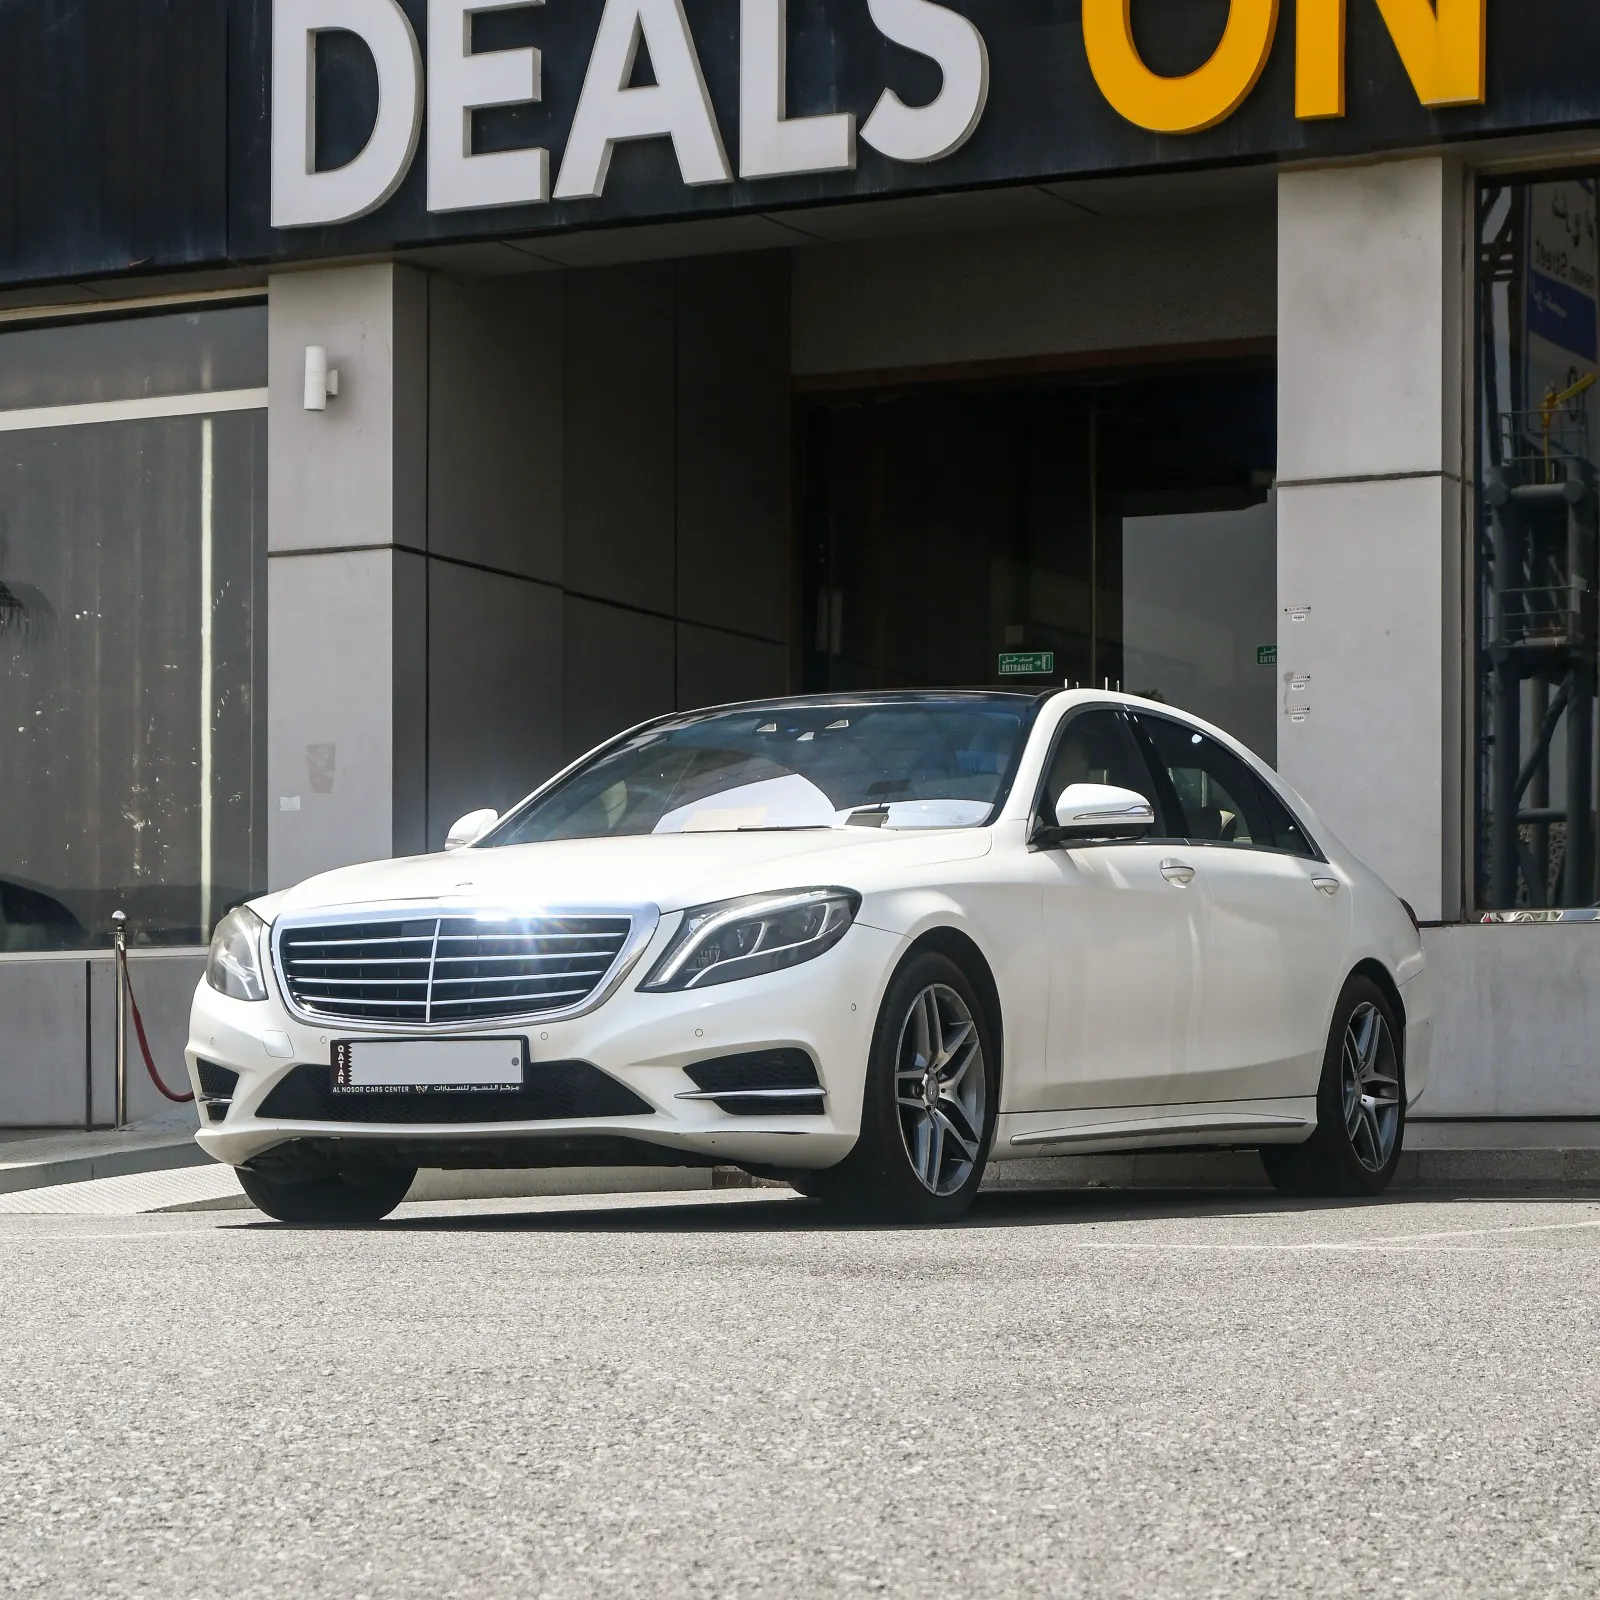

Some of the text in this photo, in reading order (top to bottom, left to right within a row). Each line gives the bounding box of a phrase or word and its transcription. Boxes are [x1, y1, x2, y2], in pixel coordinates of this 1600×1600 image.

[271, 0, 990, 229] DEALS
[1002, 655, 1034, 664] مدخل
[1260, 655, 1277, 663] ENTR
[1002, 664, 1033, 672] ENTRANCE
[337, 1044, 345, 1084] QATAR
[499, 1084, 520, 1092] مركز
